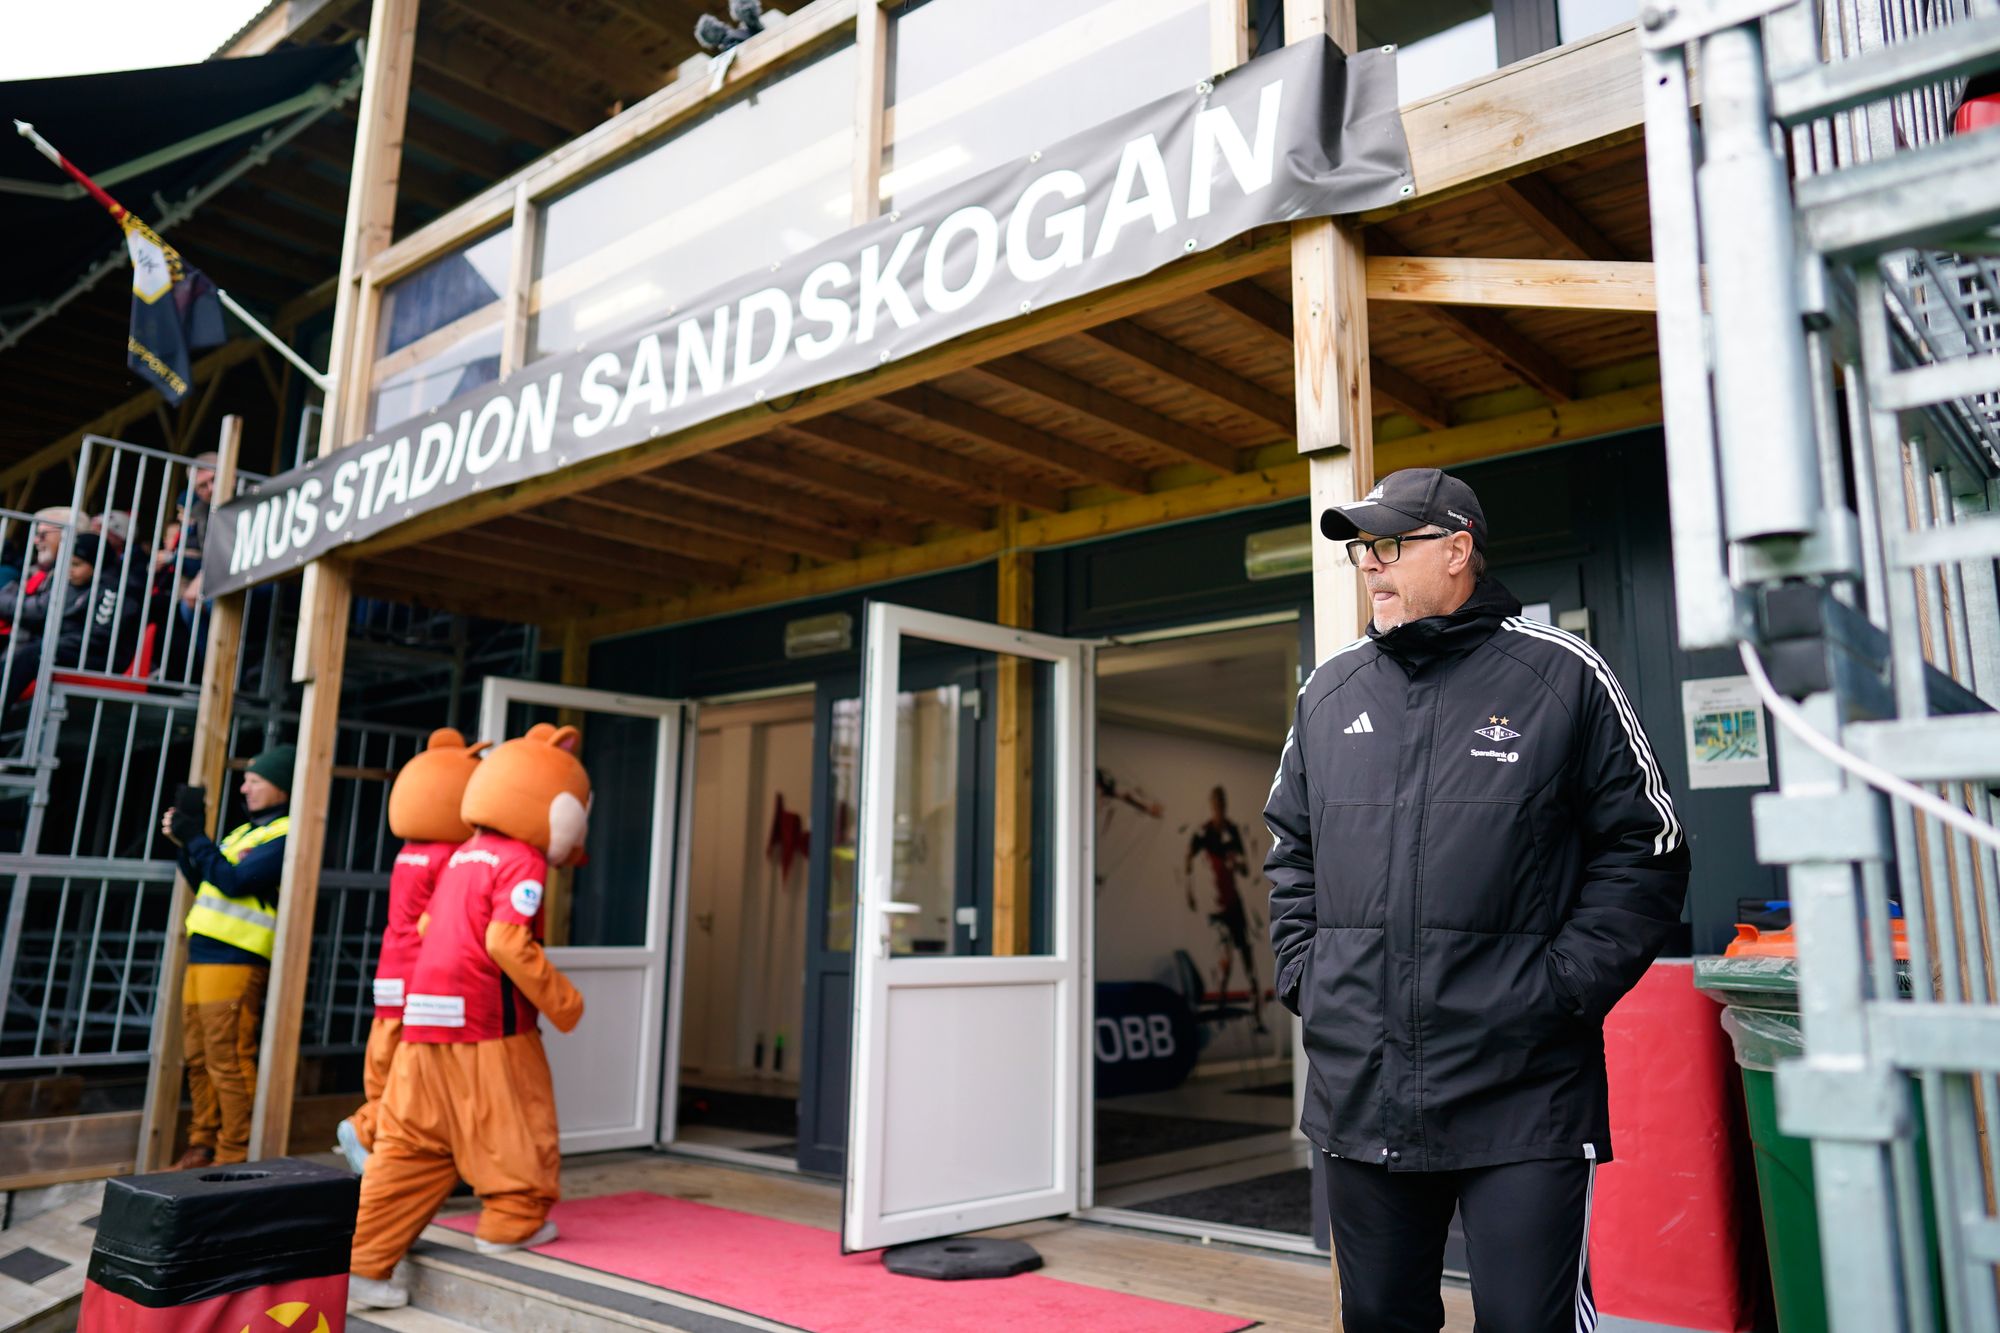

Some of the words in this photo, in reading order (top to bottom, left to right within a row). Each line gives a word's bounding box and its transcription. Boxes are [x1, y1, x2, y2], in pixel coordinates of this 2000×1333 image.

[230, 478, 323, 575] MUS
[325, 372, 563, 533] STADION
[573, 79, 1284, 439] SANDSKOGAN
[1470, 749, 1507, 758] SpareBank
